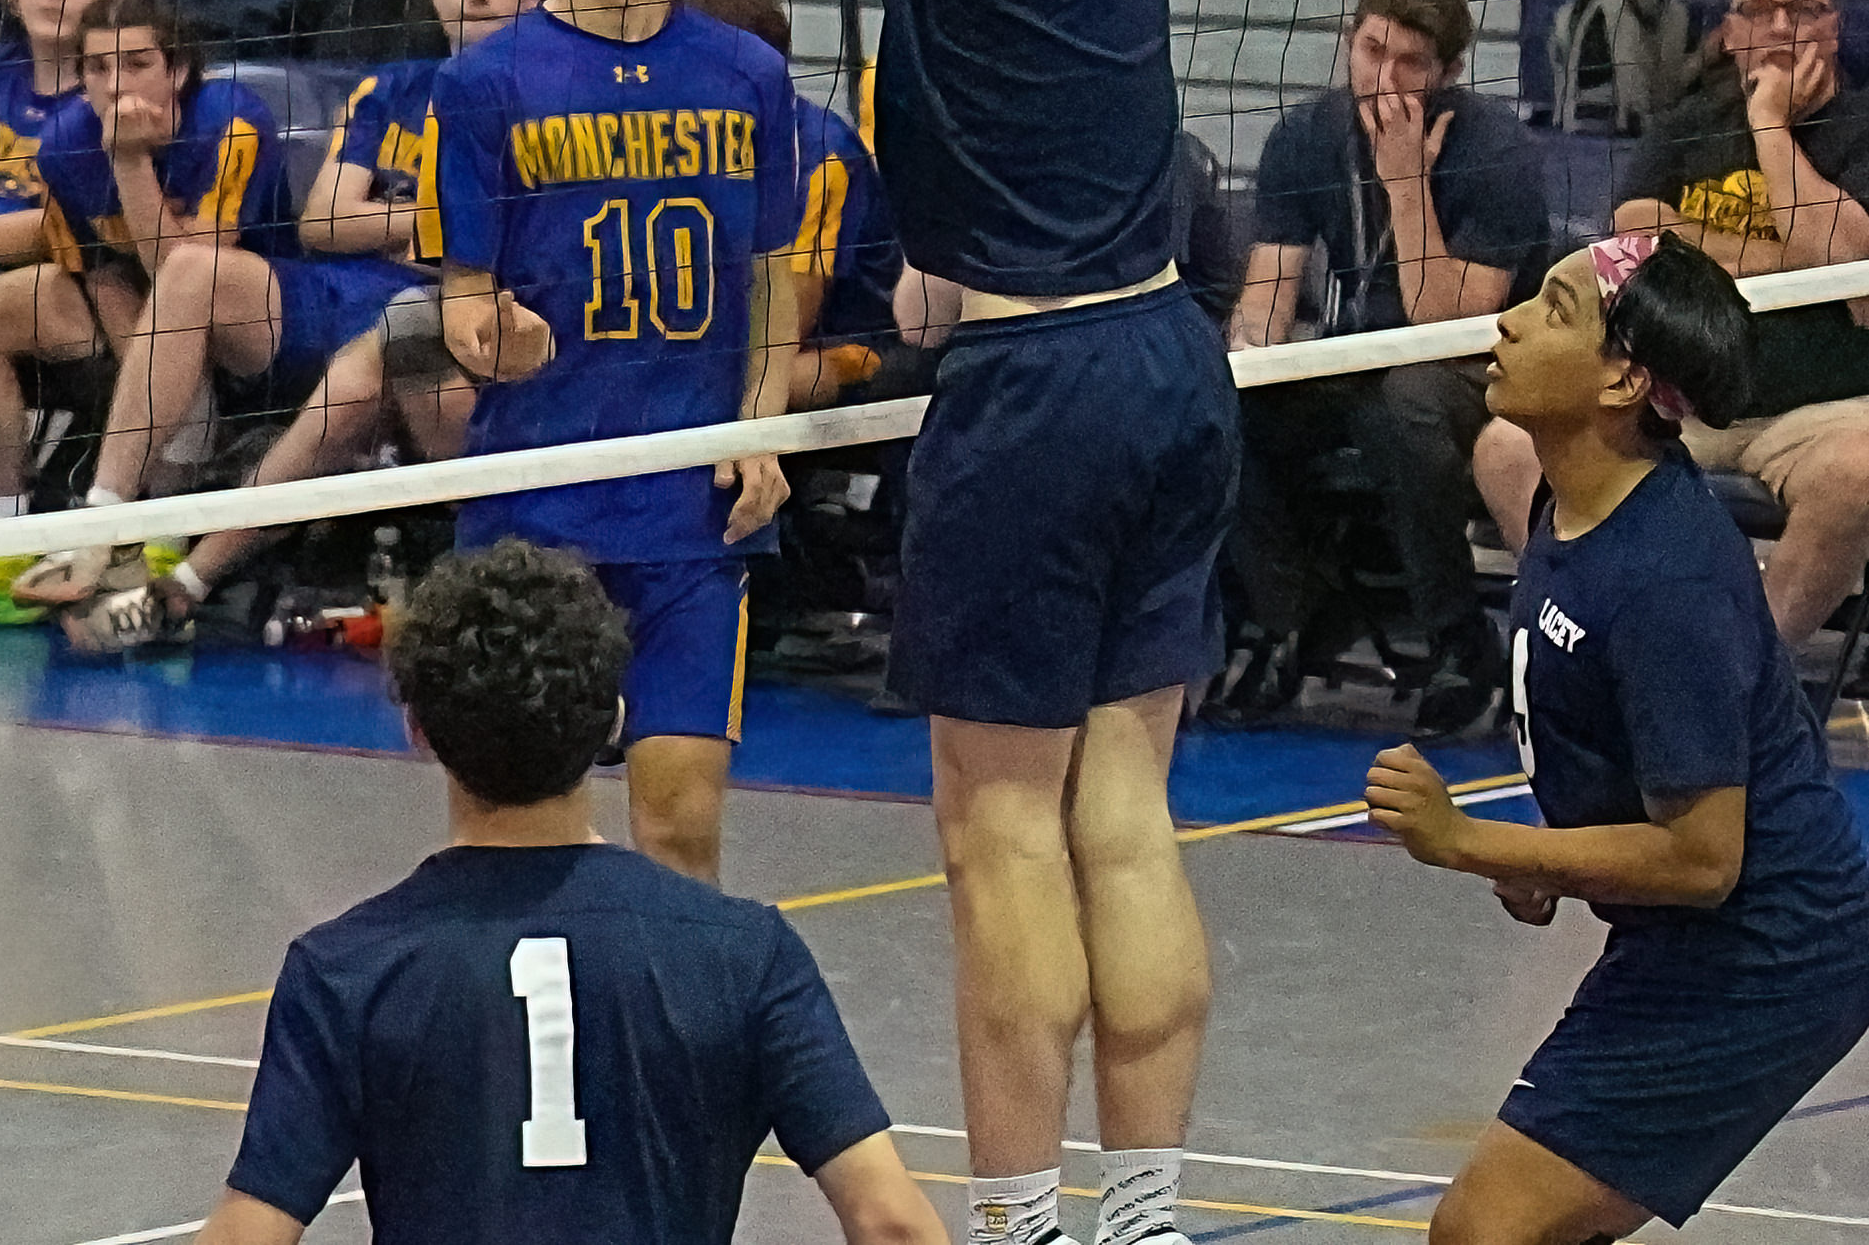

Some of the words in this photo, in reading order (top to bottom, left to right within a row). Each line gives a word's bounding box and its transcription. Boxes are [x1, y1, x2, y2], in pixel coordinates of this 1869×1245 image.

[584, 197, 714, 341] 10
[1538, 597, 1586, 653] LACEY
[510, 937, 587, 1167] 1
